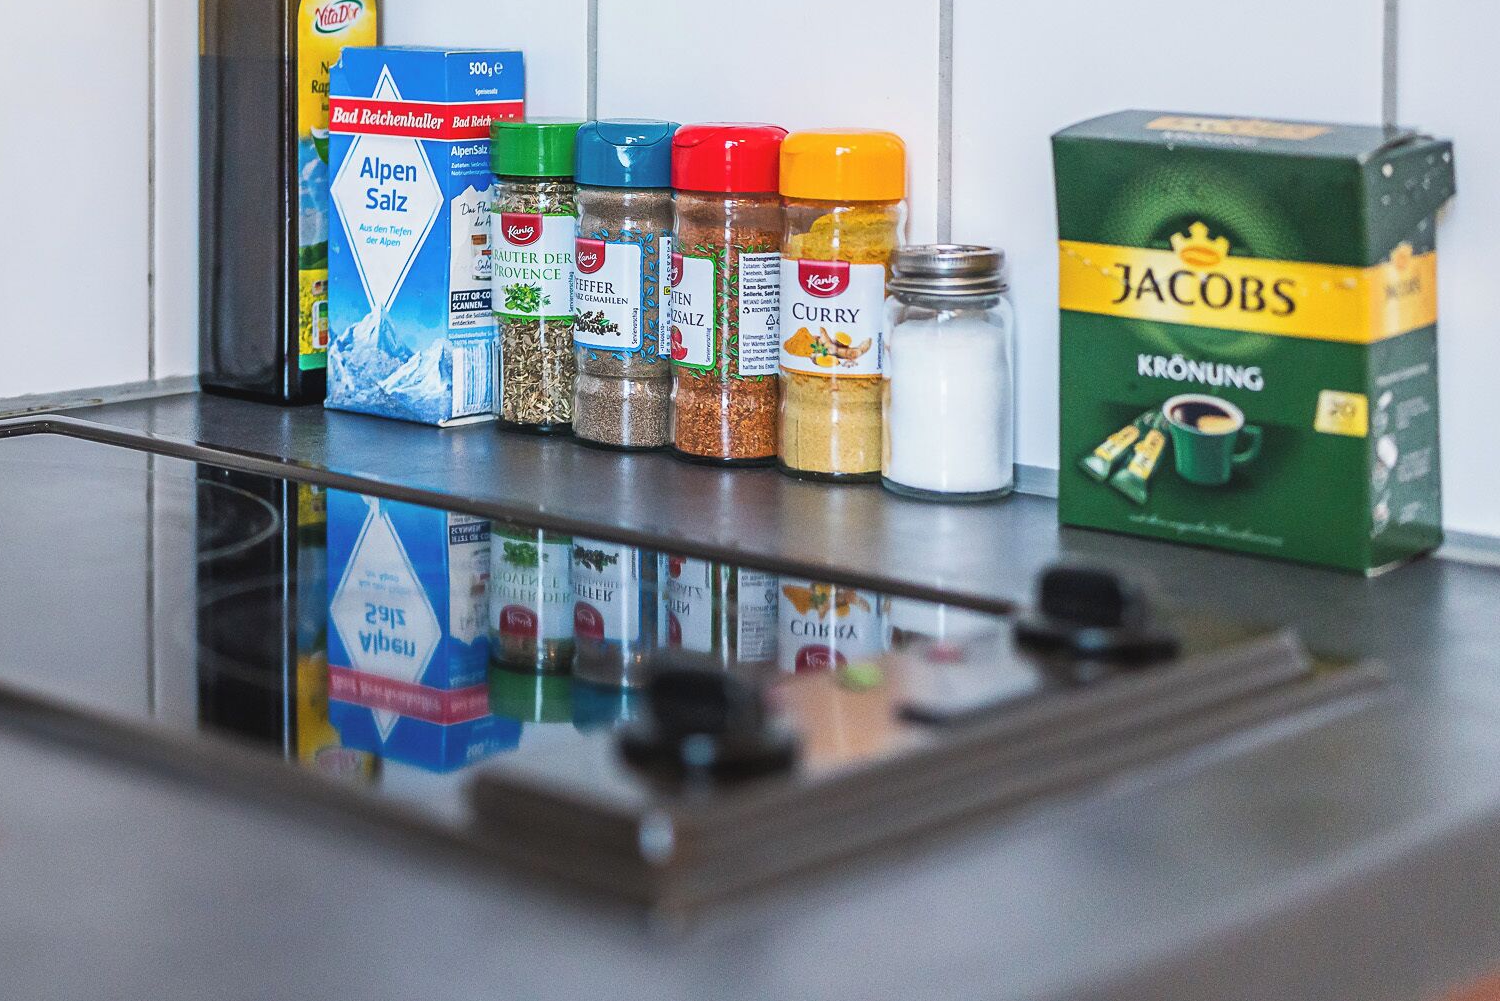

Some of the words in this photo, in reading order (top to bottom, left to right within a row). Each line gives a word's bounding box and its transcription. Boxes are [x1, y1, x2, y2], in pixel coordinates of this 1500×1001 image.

[311, 80, 330, 97] Rap
[332, 107, 358, 124] Bad
[360, 108, 444, 130] Reichenhaller
[452, 117, 470, 128] Bad
[360, 156, 417, 185] Alpen
[365, 187, 408, 212] Salz
[359, 223, 373, 232] Aus
[374, 225, 388, 234] den
[389, 226, 412, 237] Tiefen
[508, 225, 535, 239] Kania
[366, 236, 379, 244] der
[379, 237, 401, 247] Alpen
[494, 248, 539, 264] RÄUTER
[544, 253, 573, 265] DER
[494, 263, 562, 281] PROVENCE
[575, 277, 616, 295] FEFFER
[806, 274, 840, 289] Kania
[1112, 263, 1297, 317] JACOBS
[452, 292, 470, 301] JETZT
[471, 291, 491, 300] QR-CO
[584, 294, 629, 305] GEMAHLEN
[792, 302, 860, 323] CURRY
[1137, 353, 1265, 391] KRÖNUNG
